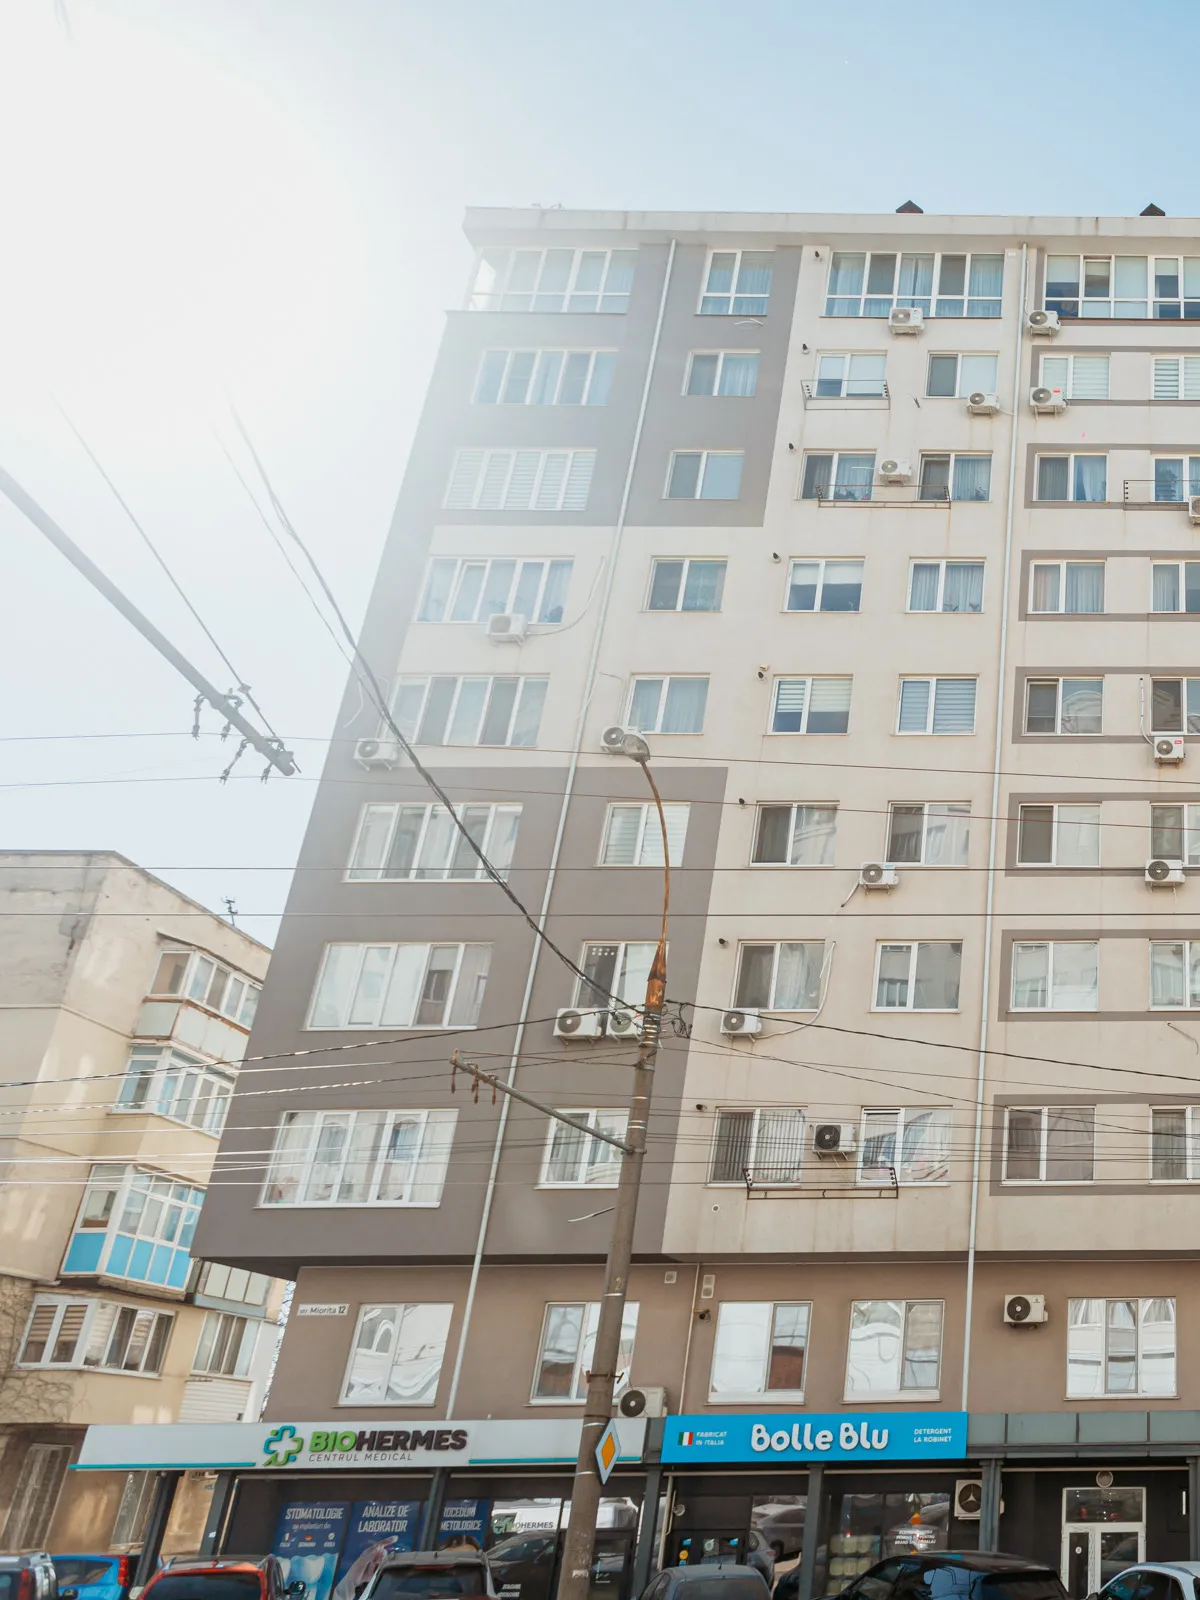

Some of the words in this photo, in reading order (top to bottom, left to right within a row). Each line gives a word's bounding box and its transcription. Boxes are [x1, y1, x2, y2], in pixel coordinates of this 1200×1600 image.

[338, 1305, 346, 1314] 12
[309, 1429, 468, 1453] BIOHERMES
[751, 1423, 834, 1452] Bolle
[839, 1421, 889, 1451] Blu
[308, 1453, 359, 1463] CENTRUL
[364, 1451, 413, 1462] MEDICAL
[285, 1507, 344, 1520] STOMATOLOGIE
[362, 1505, 397, 1518] ANALIZE
[397, 1505, 410, 1518] DE
[357, 1519, 408, 1533] LABORATOR
